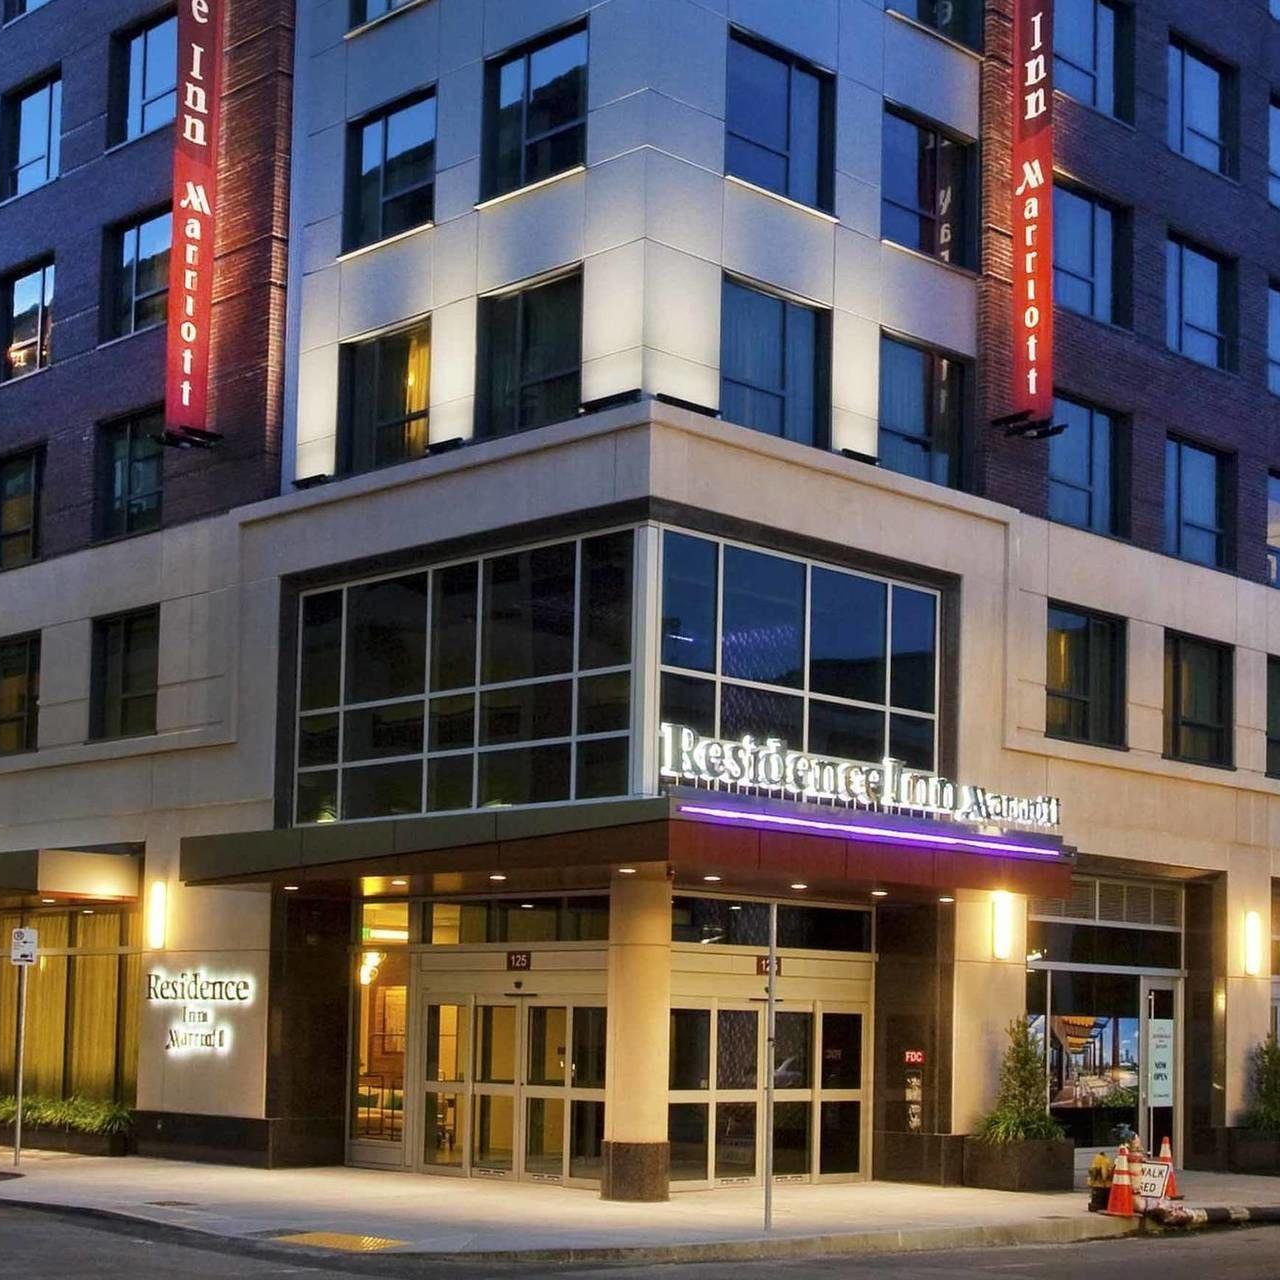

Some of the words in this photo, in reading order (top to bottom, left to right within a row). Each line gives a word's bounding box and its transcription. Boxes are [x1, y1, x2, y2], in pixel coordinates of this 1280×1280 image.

[183, 43, 208, 146] Inn
[1024, 12, 1047, 120] Inn
[180, 181, 211, 406] Marriott
[1016, 159, 1045, 394] Marriott
[660, 722, 881, 804] Residence
[881, 757, 956, 813] Inn
[146, 972, 250, 1001] Residence
[512, 955, 527, 966] 125
[181, 1006, 208, 1023] Inn
[905, 1052, 923, 1062] FDC
